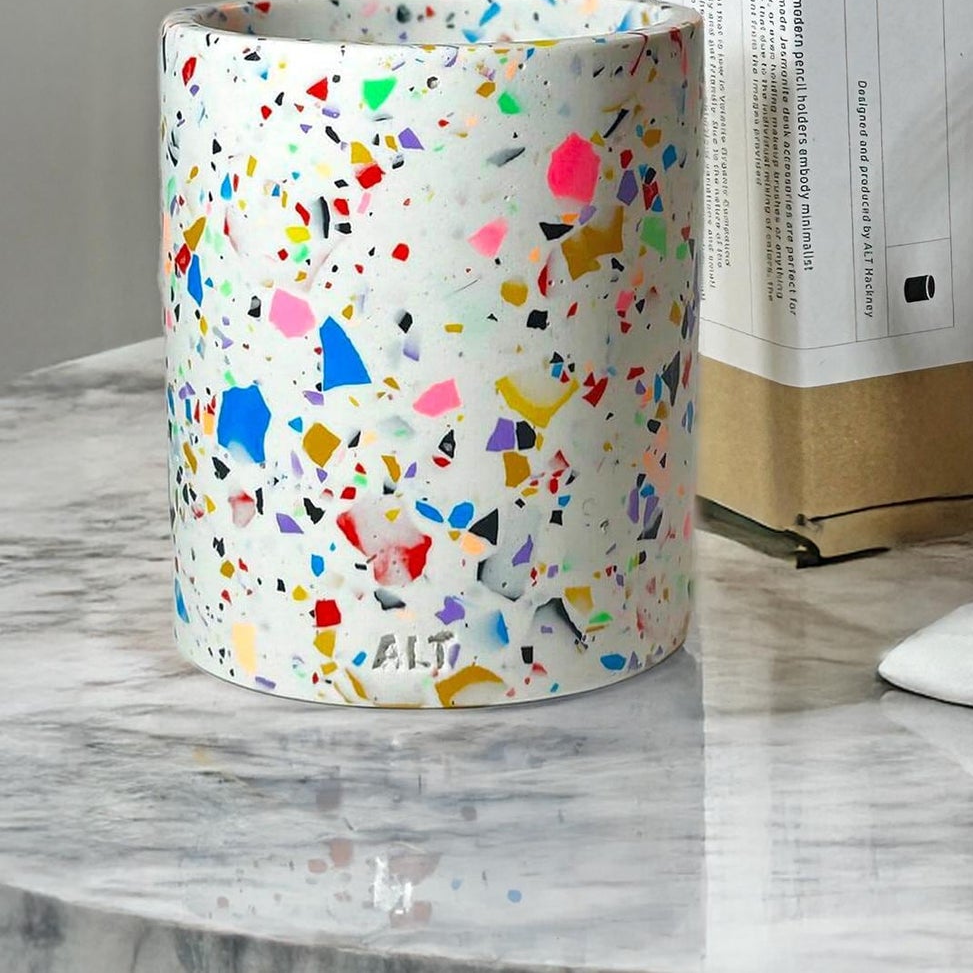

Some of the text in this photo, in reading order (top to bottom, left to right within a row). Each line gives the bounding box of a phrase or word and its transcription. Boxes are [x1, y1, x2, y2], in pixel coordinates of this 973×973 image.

[792, 51, 807, 91] pencil
[797, 95, 808, 145] holders
[798, 148, 811, 199] embody
[856, 80, 874, 318] Designed and produced by ALT Hackney
[801, 203, 814, 271] minimalist
[774, 243, 784, 299] anything
[785, 245, 796, 293] perfect
[789, 297, 798, 315] for
[371, 631, 455, 670] ALT
